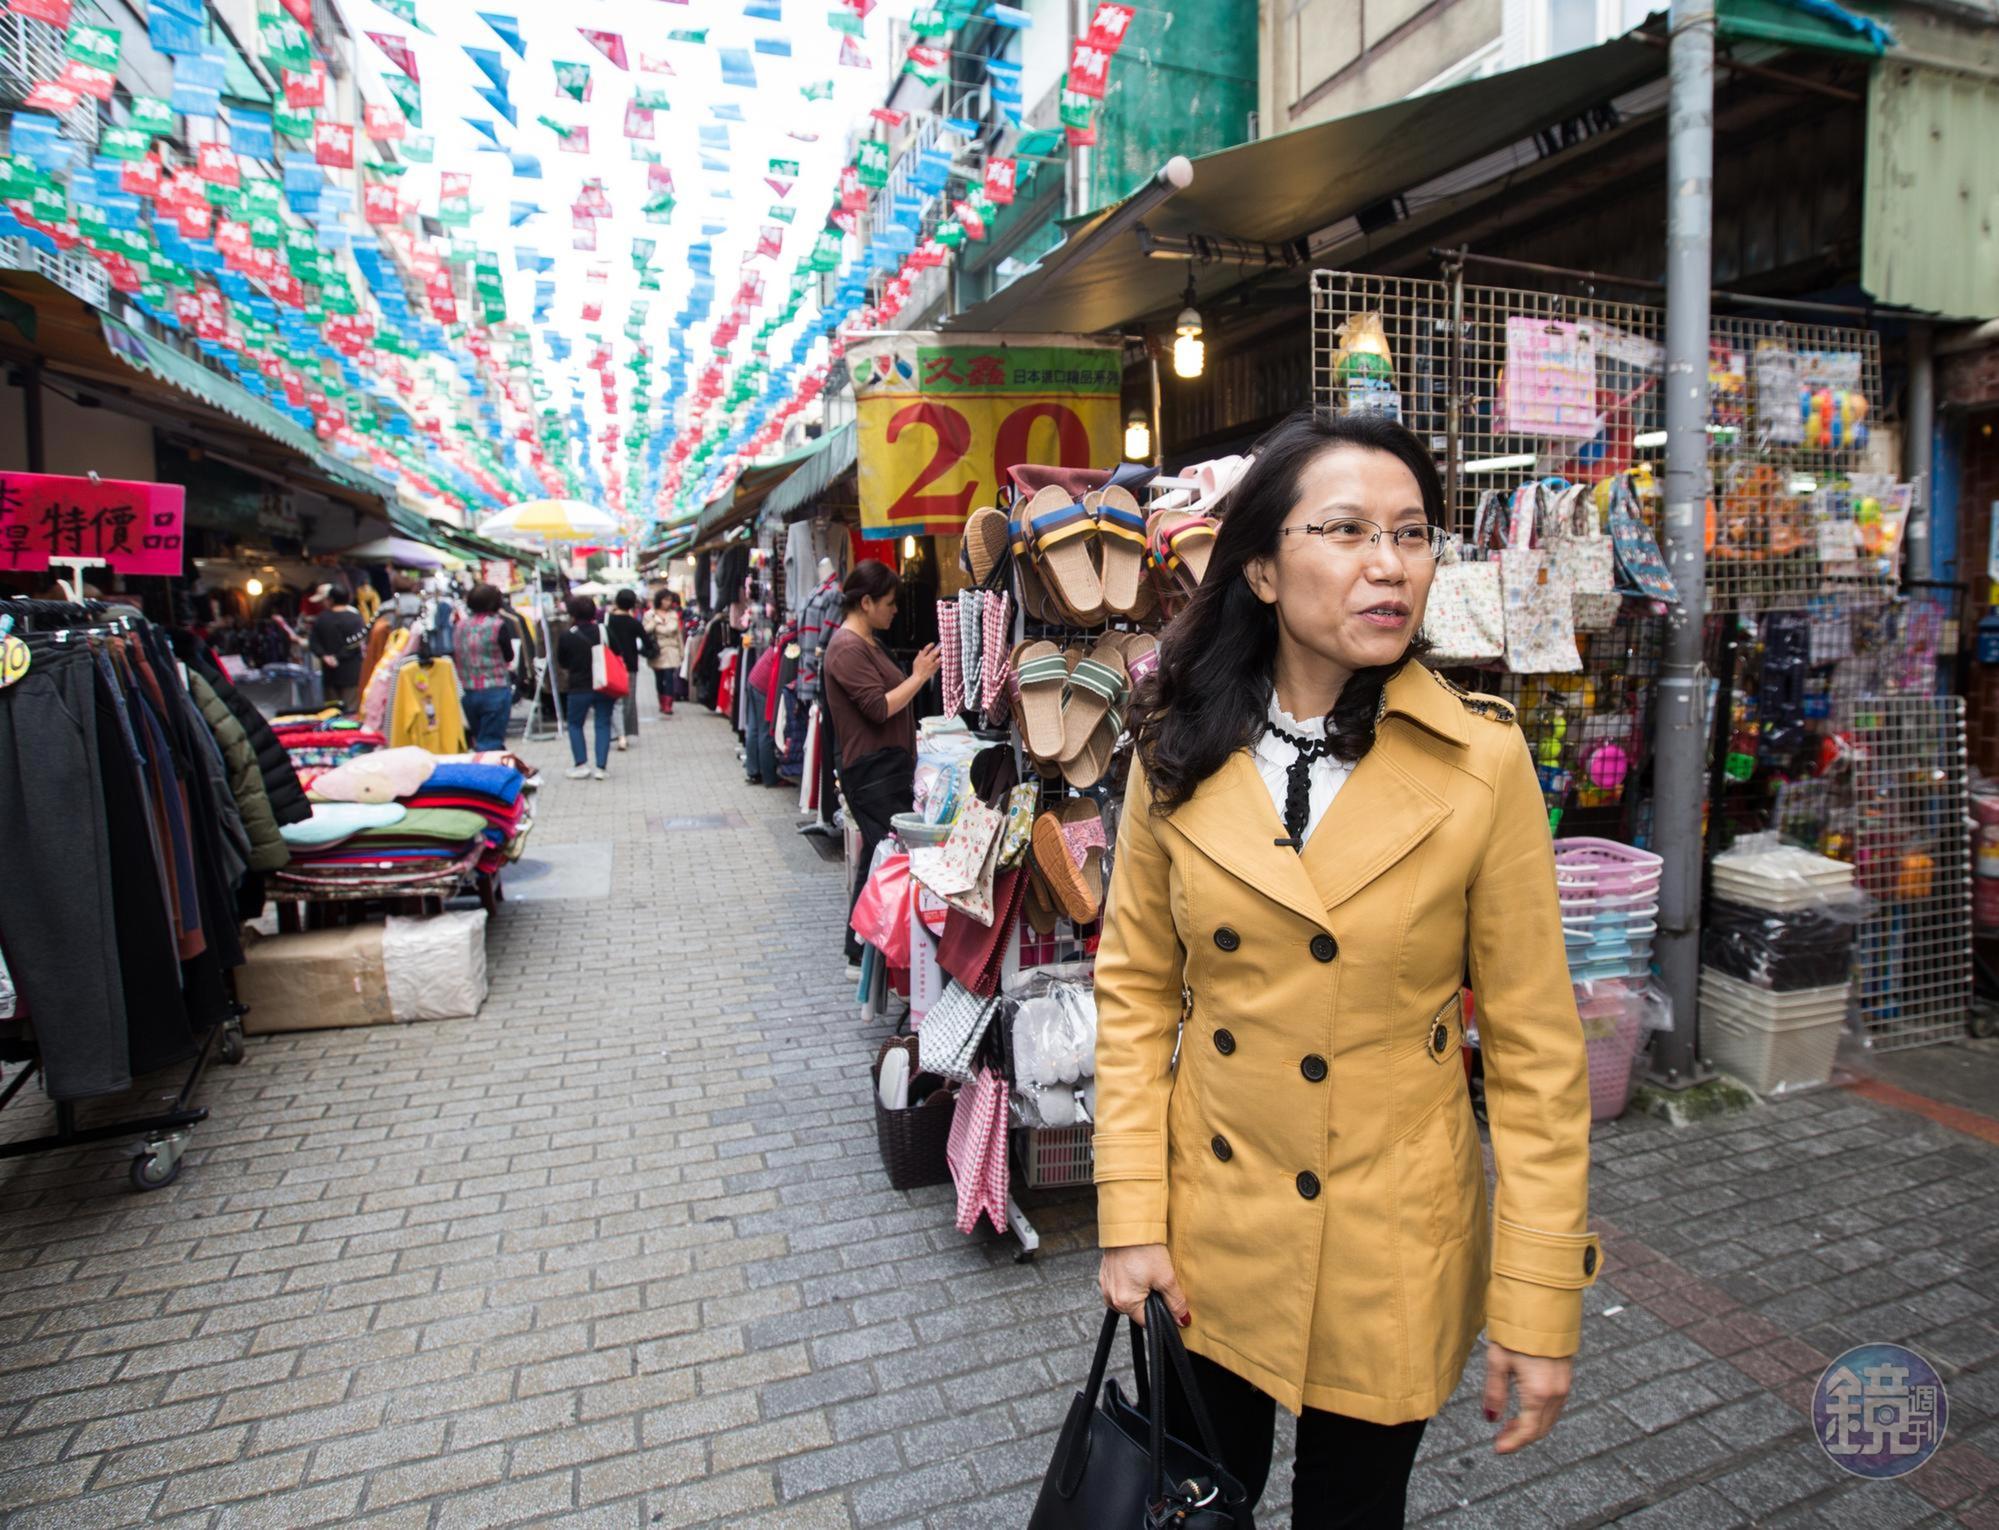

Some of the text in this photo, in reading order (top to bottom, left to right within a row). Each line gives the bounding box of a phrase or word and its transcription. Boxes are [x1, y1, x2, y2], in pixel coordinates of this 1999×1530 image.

[925, 355, 1006, 387] 久鑫
[1013, 368, 1120, 386] 日本進口精品系列
[886, 402, 1091, 520] 20
